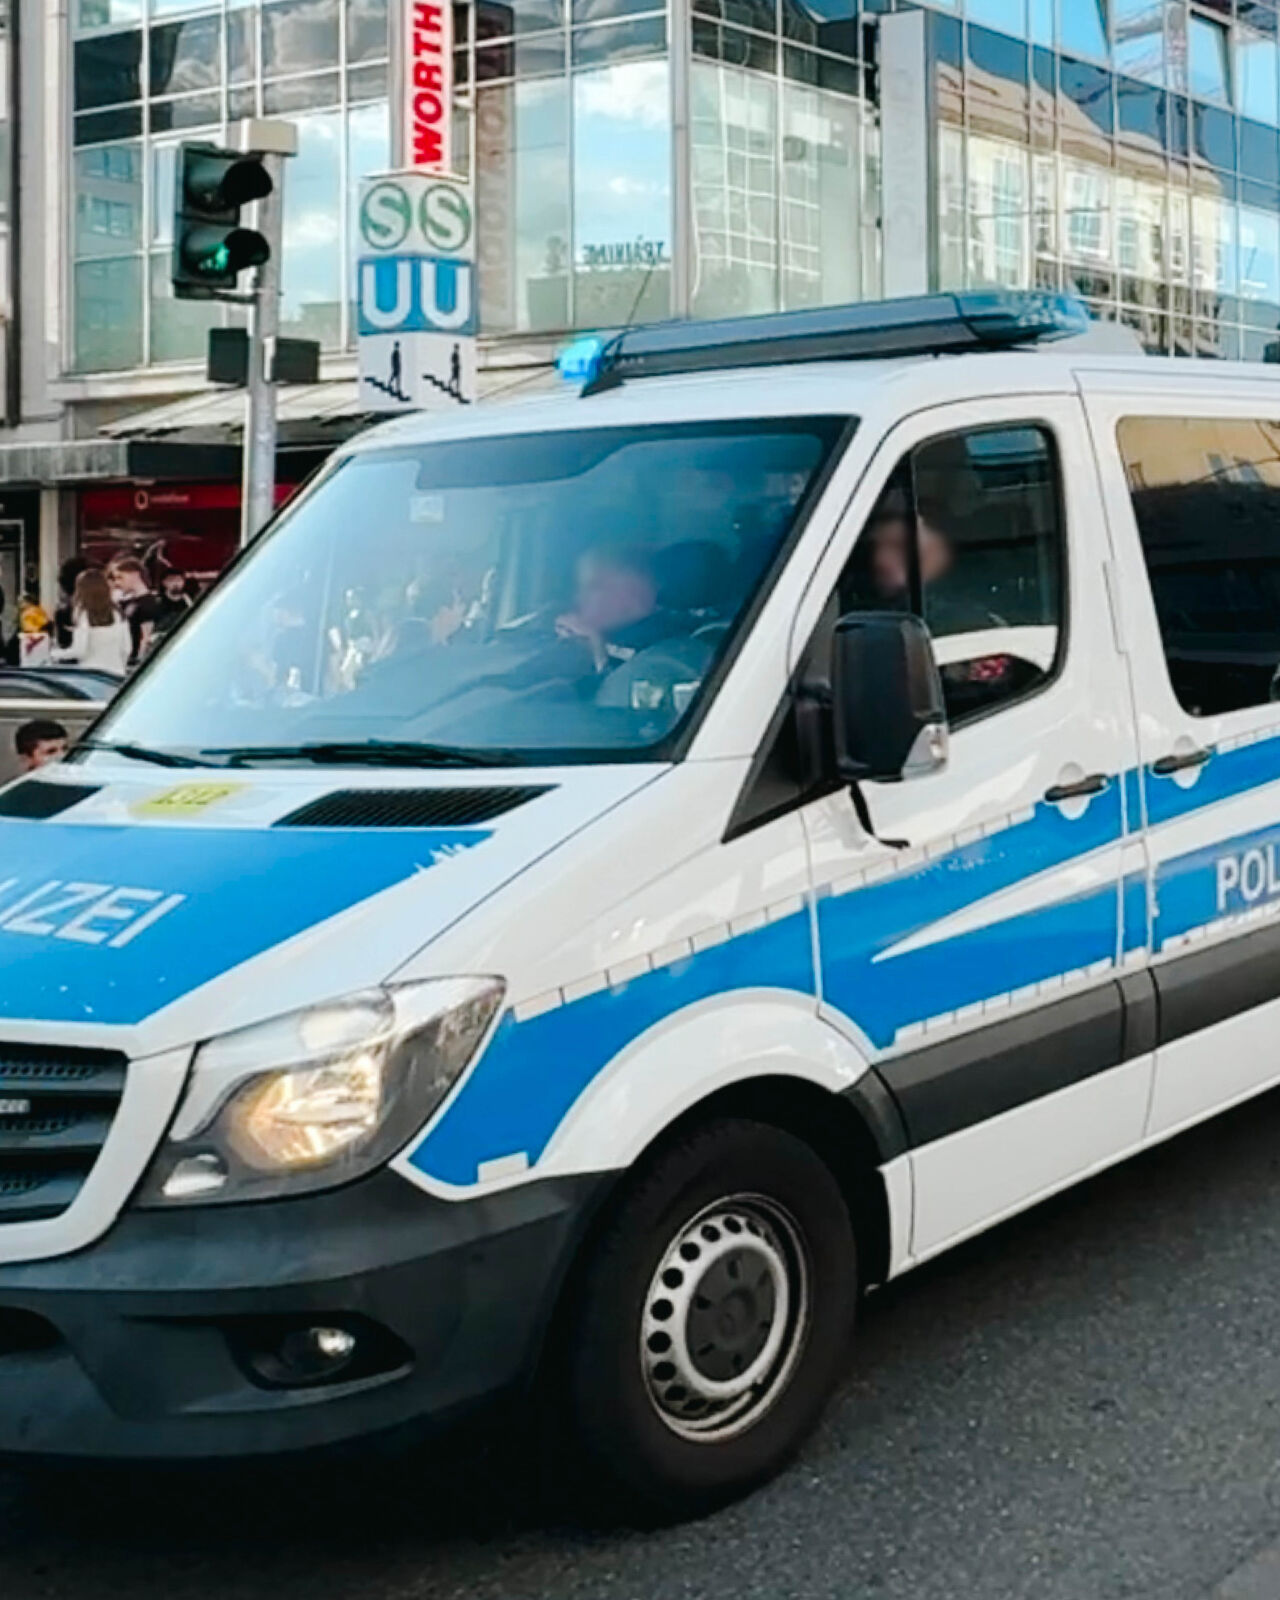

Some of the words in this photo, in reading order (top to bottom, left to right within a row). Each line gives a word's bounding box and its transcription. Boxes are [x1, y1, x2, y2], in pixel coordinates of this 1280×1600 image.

[413, 2, 443, 171] WORTH
[364, 184, 409, 248] S
[423, 186, 468, 249] S
[362, 261, 411, 328] U
[421, 261, 470, 329] U
